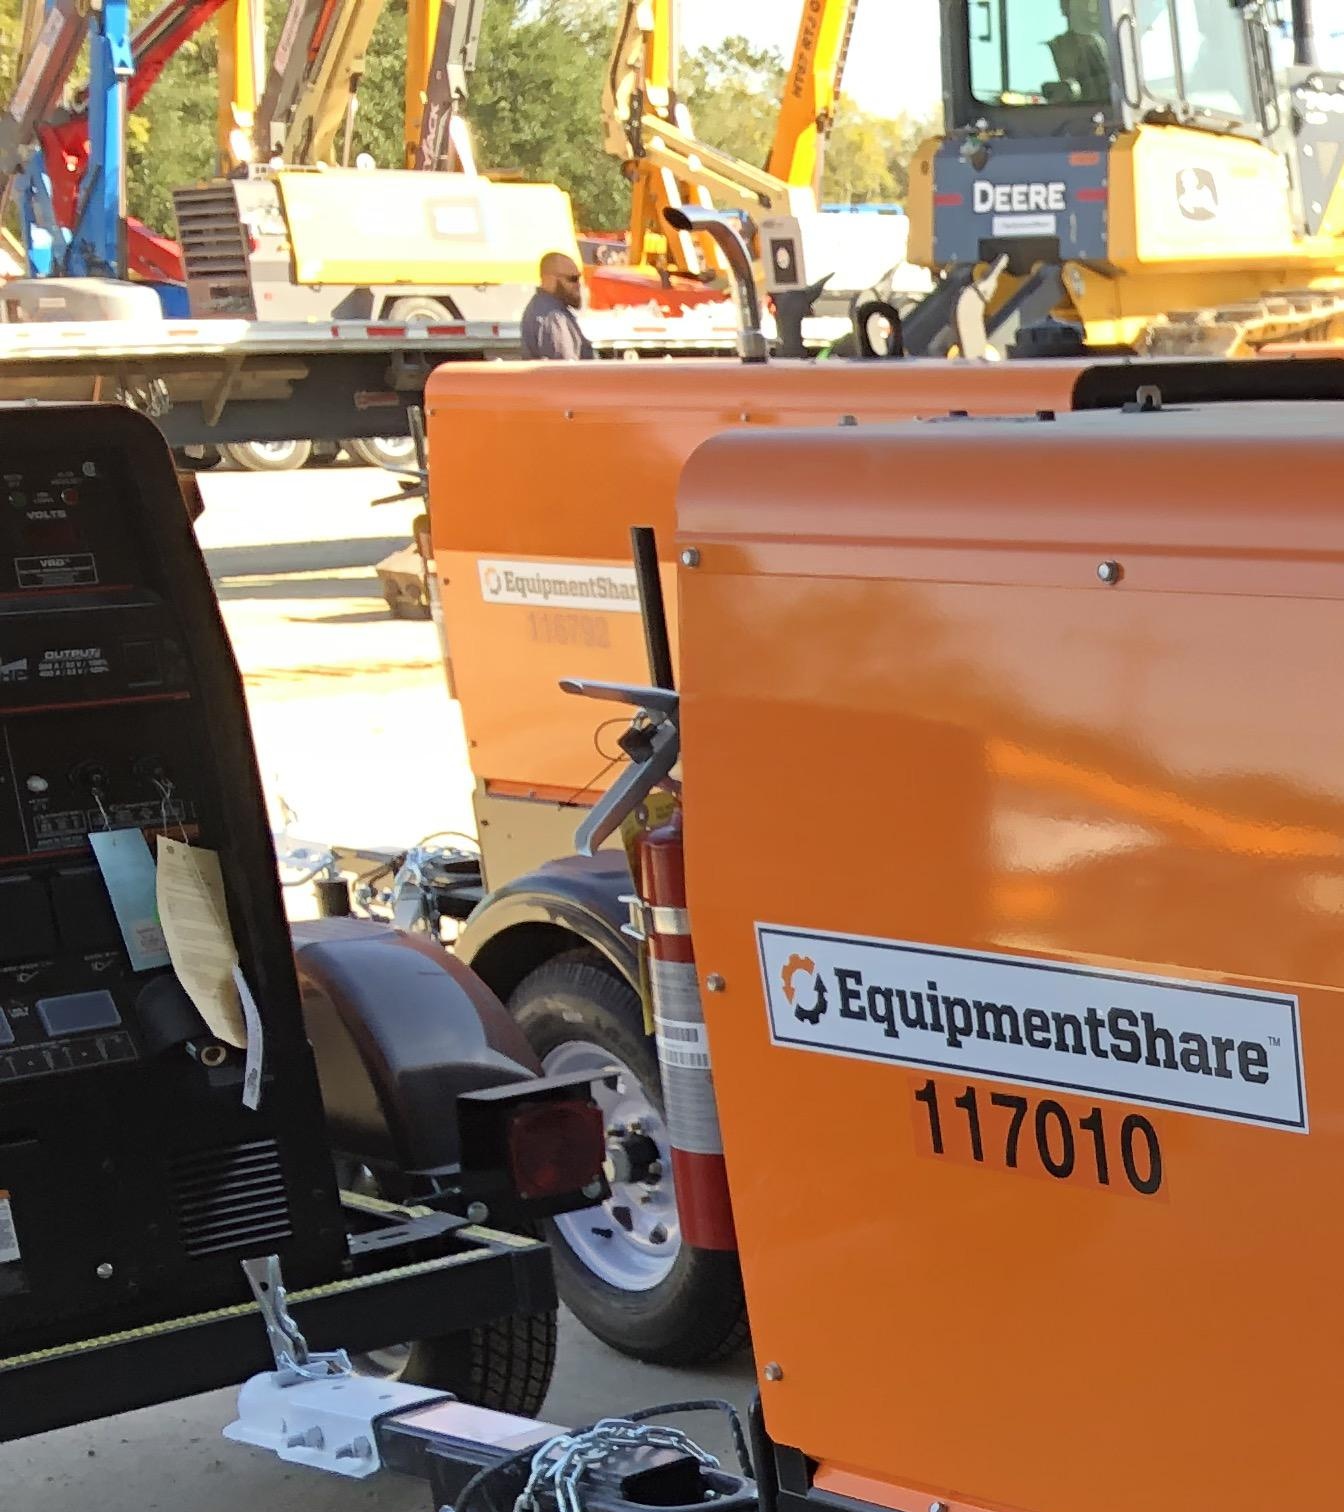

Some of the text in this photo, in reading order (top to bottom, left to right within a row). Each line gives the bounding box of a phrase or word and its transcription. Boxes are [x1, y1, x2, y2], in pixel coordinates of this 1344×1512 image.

[973, 181, 1066, 213] DEERE
[503, 571, 640, 601] EquipmentShar
[833, 967, 1270, 1084] EquipmentShare
[914, 1079, 1163, 1195] 117010
